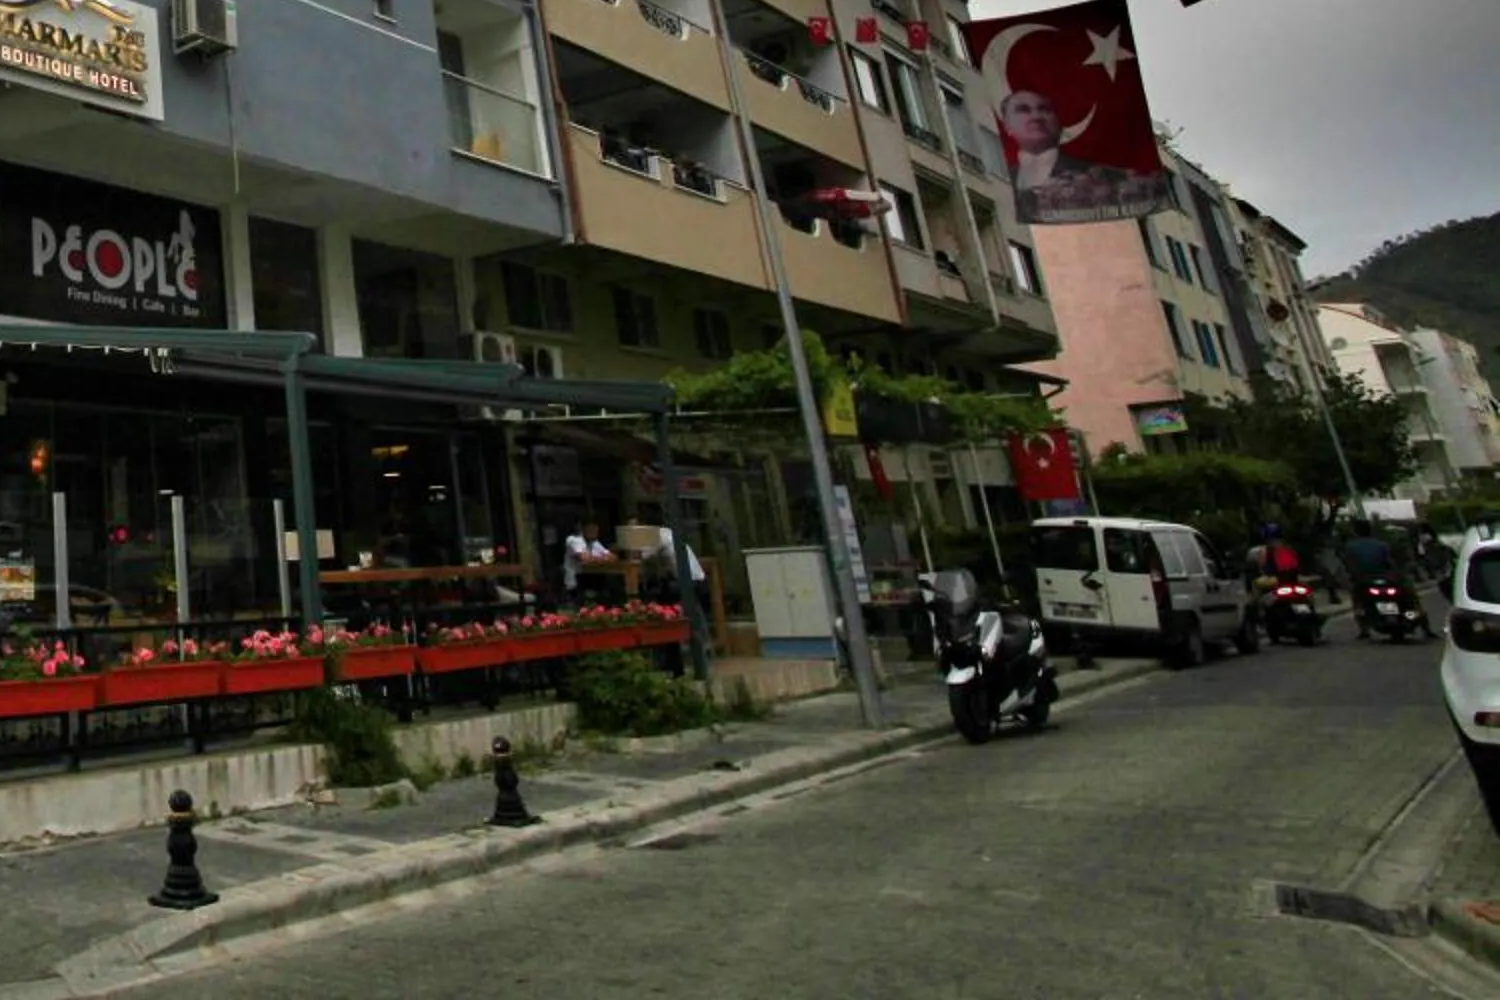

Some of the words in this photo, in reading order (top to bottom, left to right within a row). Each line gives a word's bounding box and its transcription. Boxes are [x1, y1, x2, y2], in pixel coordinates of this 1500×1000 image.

[1, 44, 84, 80] BOUTIQUE
[89, 71, 139, 96] HOTEL
[31, 215, 198, 301] PEOPLE
